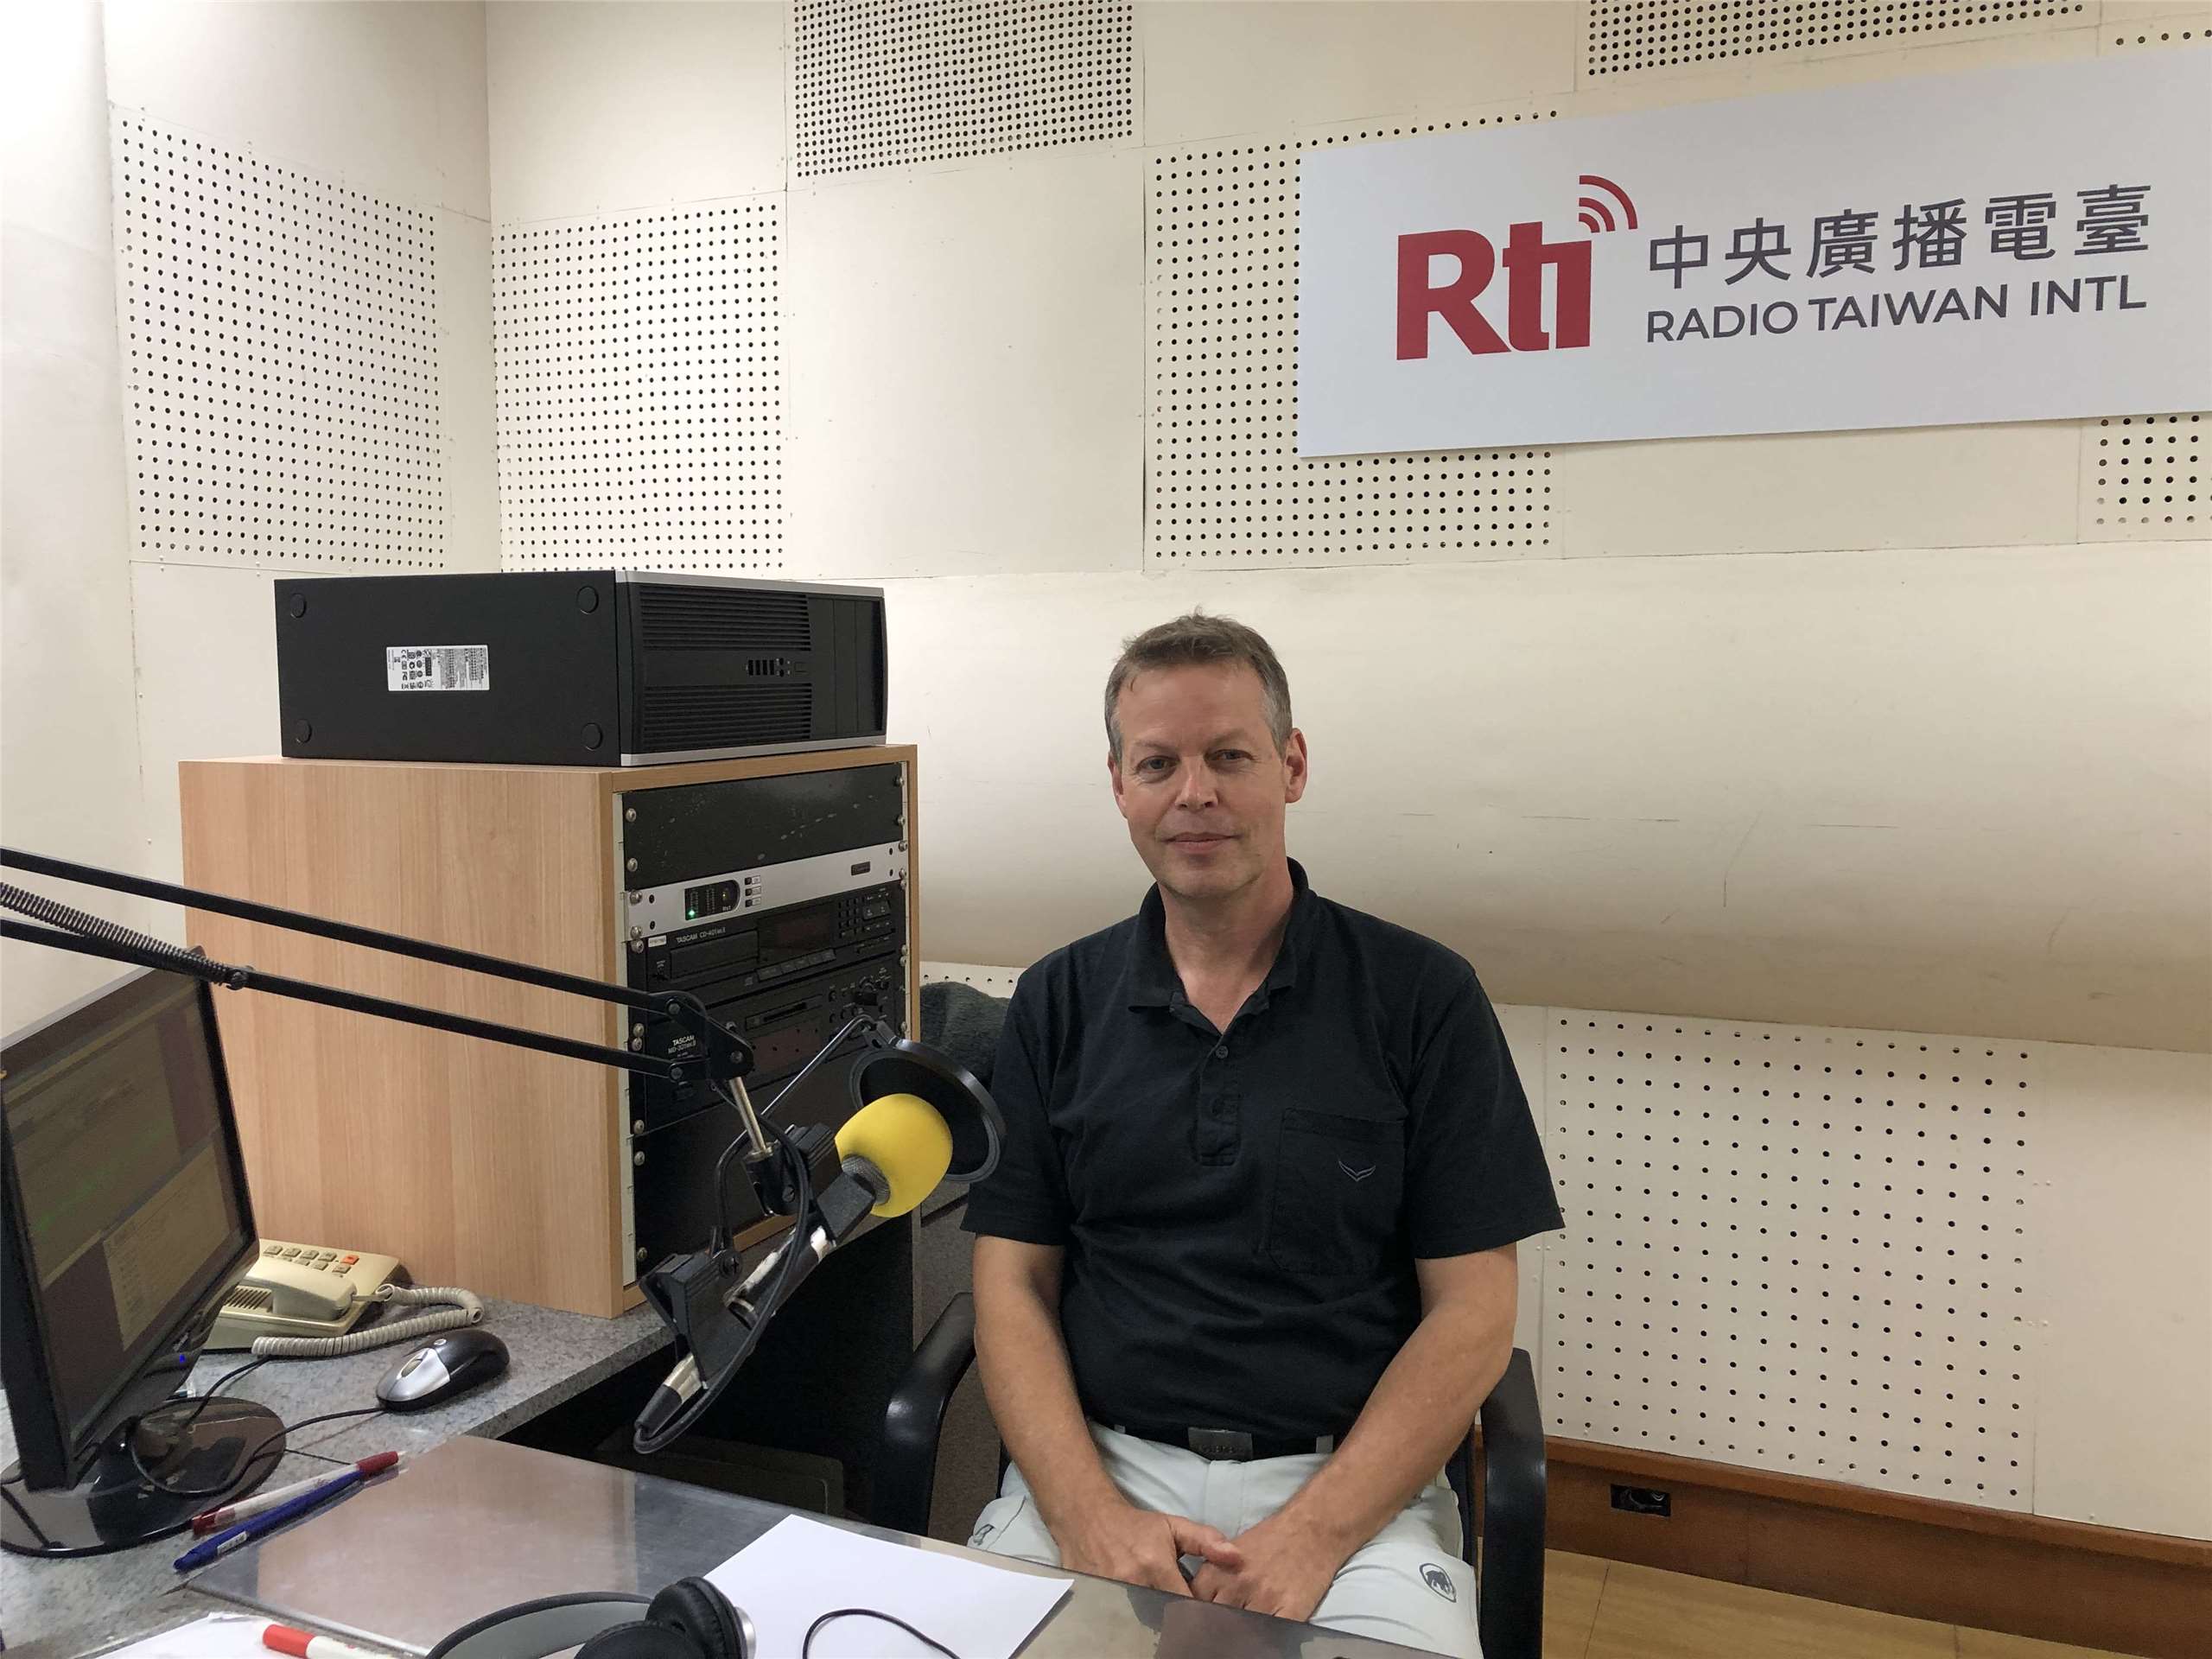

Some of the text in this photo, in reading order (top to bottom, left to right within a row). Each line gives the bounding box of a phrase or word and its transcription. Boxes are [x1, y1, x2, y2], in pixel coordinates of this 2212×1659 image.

[1649, 183, 2152, 289] 中央廣播電臺
[1396, 216, 1592, 360] Rti
[1647, 274, 2147, 343] RADIO TAIWAN INTL
[676, 933, 698, 944] TASCAM
[672, 1035, 695, 1046] TASCAM
